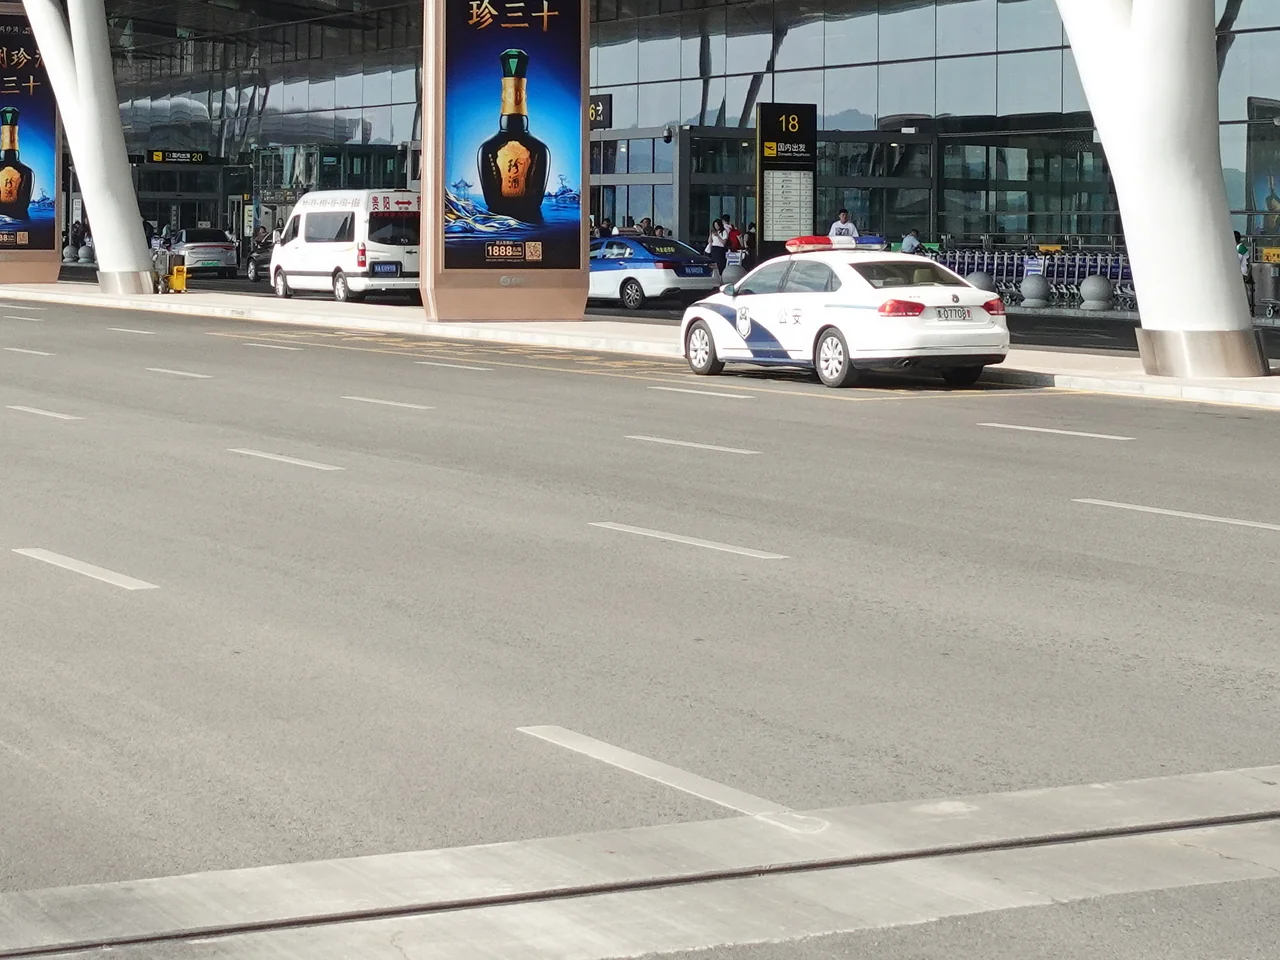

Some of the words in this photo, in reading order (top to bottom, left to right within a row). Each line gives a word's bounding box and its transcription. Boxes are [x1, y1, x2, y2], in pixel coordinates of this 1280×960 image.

[779, 114, 799, 132] 18
[777, 142, 806, 152] 国内出发
[191, 152, 203, 162] 20
[487, 245, 513, 256] 1888
